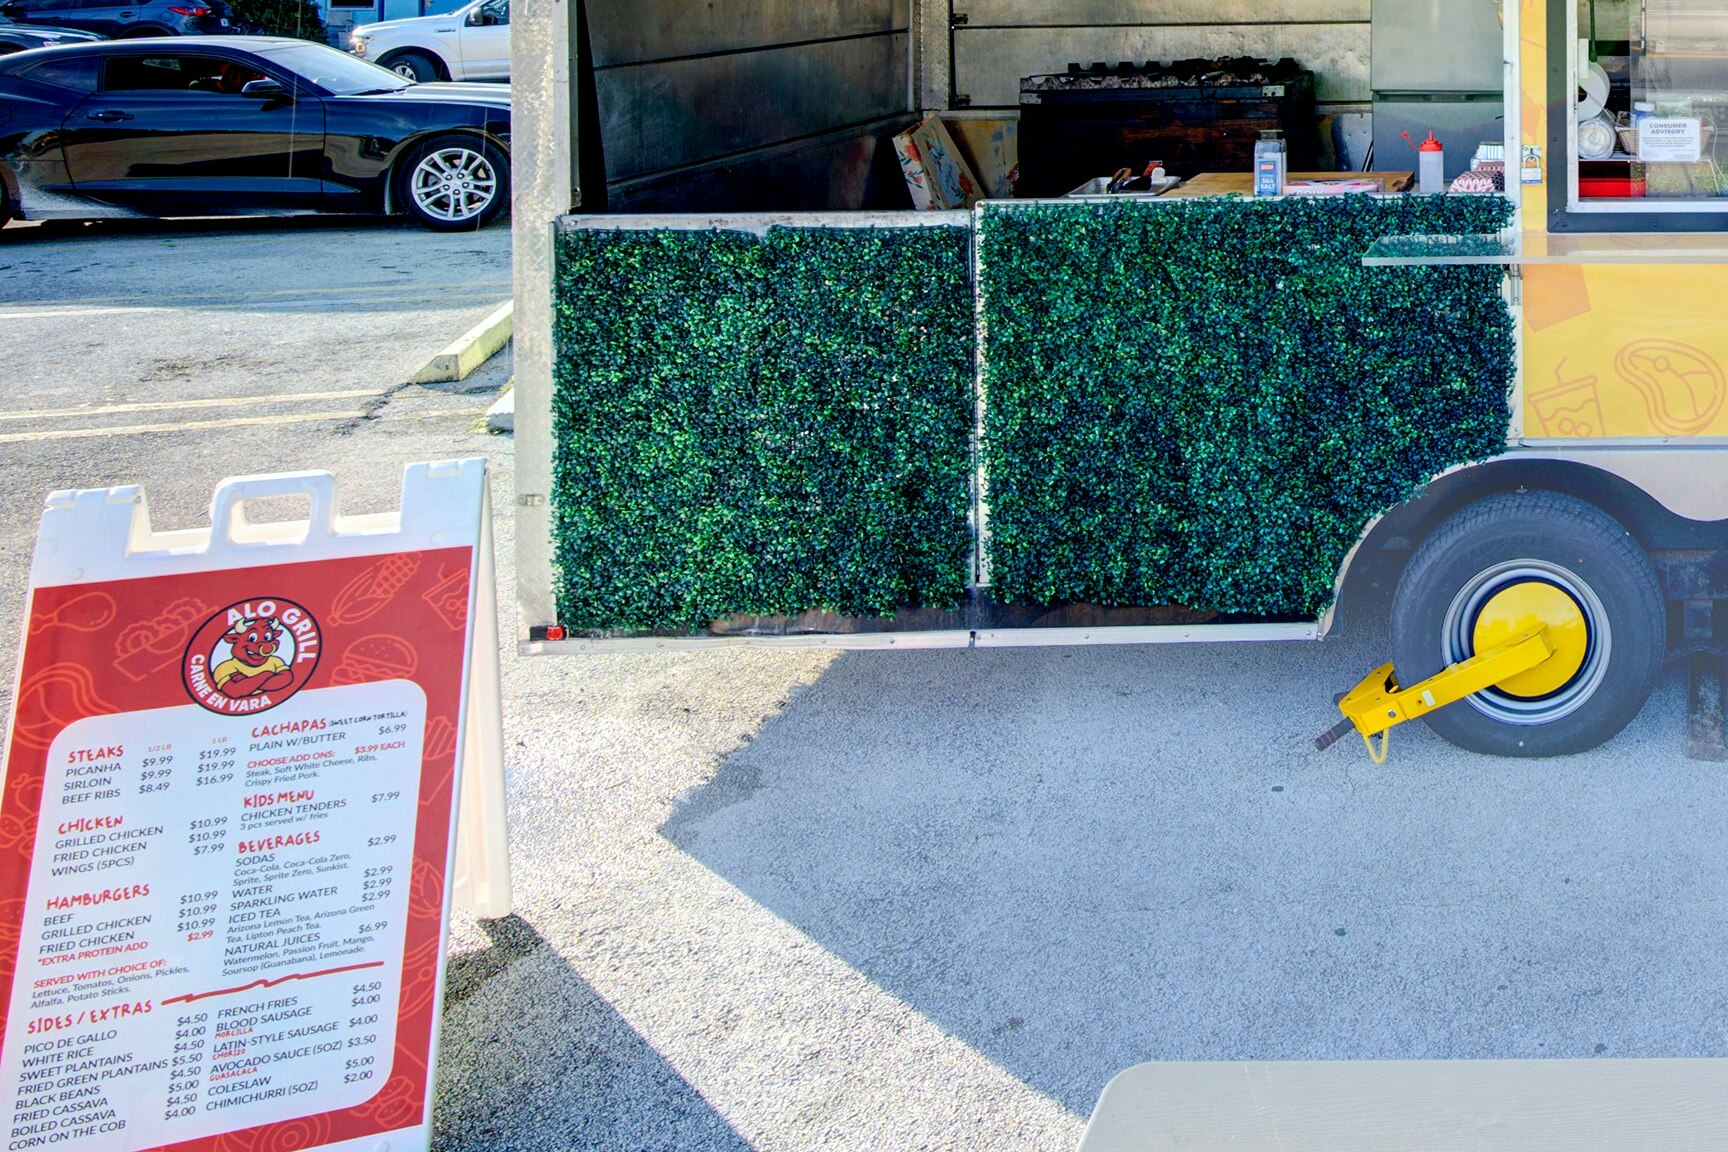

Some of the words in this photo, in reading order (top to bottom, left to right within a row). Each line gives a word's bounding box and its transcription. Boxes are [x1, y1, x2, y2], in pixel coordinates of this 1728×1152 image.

[227, 600, 276, 626] ALO
[282, 608, 317, 663] GRILL
[190, 654, 212, 698] CARNE
[206, 693, 228, 709] EN
[229, 696, 272, 711] VARA
[249, 740, 283, 752] PLAIN
[286, 732, 346, 747] W/BUTTER
[379, 724, 407, 735] $6.99
[251, 718, 327, 739] CACHAPAS
[66, 762, 121, 777] PICANHA
[142, 756, 173, 768] $9.99
[199, 748, 236, 760] $19.99
[68, 745, 123, 763] STEAKS
[247, 756, 287, 769] CHOOSE
[290, 753, 310, 762] ADD
[313, 750, 335, 759] ONS:
[355, 744, 378, 754] $3.99
[381, 741, 405, 750] EACH
[62, 792, 92, 804] BEEF
[94, 789, 121, 800] RIBS
[139, 782, 170, 794] $8.49
[196, 773, 233, 786] $16.99
[64, 777, 112, 791] SIRLOIN
[141, 769, 172, 781] $9.99
[198, 760, 235, 773] $19.99
[241, 805, 293, 821] CHICKEN
[296, 799, 347, 812] TENDERS
[372, 791, 400, 803] $7.99
[244, 793, 274, 808] KIDS
[277, 790, 314, 803] MENU
[55, 834, 106, 849] GRILLED
[109, 826, 163, 841] CHICKEN
[190, 817, 228, 829] $10.99
[58, 815, 124, 834] CHICKEN
[53, 850, 89, 863] FRIED
[92, 842, 147, 857] CHICKEN
[188, 830, 226, 843] $10.99
[235, 853, 275, 867] SODAS
[368, 835, 396, 846] $2.99
[238, 830, 320, 854] BEVERAGES
[52, 863, 94, 876] WINGS
[97, 856, 135, 871] (5PCS)
[193, 843, 224, 855] $7.99
[44, 913, 74, 926] BEEF
[180, 890, 218, 904] $10.99
[46, 883, 150, 911] HAMBURGERS
[230, 893, 295, 911] SPARKLING
[298, 886, 338, 900] WATER
[363, 878, 392, 890] $2.99
[39, 941, 75, 954] FRIED
[79, 931, 135, 947] CHICKEN
[177, 918, 215, 932] $10.99
[41, 924, 93, 940] GRILLED
[96, 915, 152, 931] CHICKEN
[179, 904, 217, 918] $10.99
[78, 945, 122, 960] PROTEIN
[125, 941, 148, 951] ADD
[187, 930, 214, 942] $2.99
[225, 939, 279, 956] NATURAL
[281, 932, 320, 947] JUICES
[358, 921, 388, 933] $6.99
[34, 975, 74, 989] SERVED
[76, 969, 105, 982] WITH
[108, 961, 148, 975] CHOICE
[150, 959, 166, 969] OF:
[216, 1017, 258, 1032] BLOOD
[260, 1006, 313, 1024] SAUSAGE
[351, 994, 380, 1007] $4.00
[218, 1004, 265, 1019] FRENCH
[267, 996, 298, 1010] FRIES
[352, 981, 381, 994] $4.50
[27, 1013, 72, 1034] SIDES
[77, 1011, 85, 1025] /
[90, 1000, 152, 1024] EXTRAS
[215, 1027, 253, 1039] MORCILLA
[24, 1041, 54, 1054] PICO
[57, 1038, 74, 1049] DE
[77, 1030, 117, 1045] GALLO
[177, 1013, 208, 1027] $4.50
[17, 1081, 54, 1096] FRIED
[56, 1072, 98, 1088] GREEN
[101, 1059, 168, 1080] PLANTAINS
[172, 1052, 203, 1067] $5.50
[19, 1066, 62, 1083] SWEET
[65, 1052, 133, 1074] PLANTAINS
[174, 1039, 205, 1053] $4.50
[207, 1076, 272, 1096] COLESLAW
[345, 1056, 375, 1070] $5.00
[205, 1088, 286, 1111] CHIMICHURRI
[343, 1070, 373, 1084] $2.00
